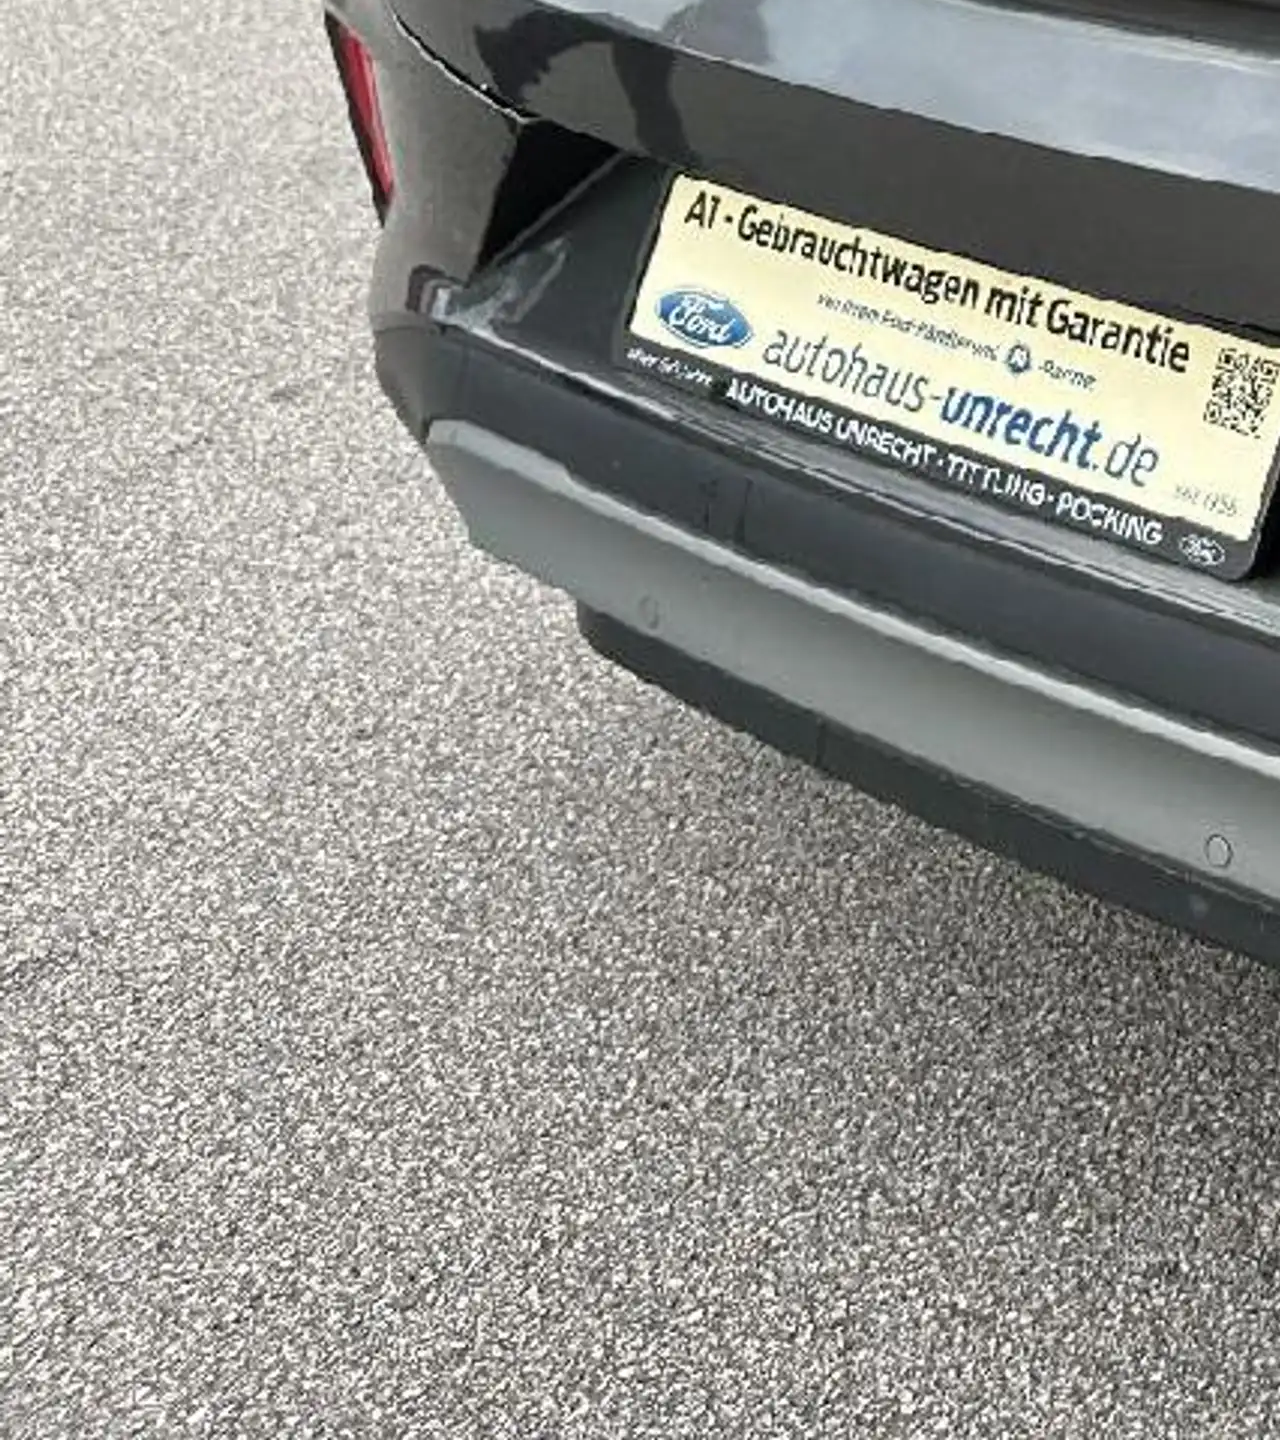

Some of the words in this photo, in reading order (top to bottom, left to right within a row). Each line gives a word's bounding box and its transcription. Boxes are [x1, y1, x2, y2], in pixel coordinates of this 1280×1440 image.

[737, 205, 980, 310] Gebrauchtwagen
[985, 286, 1043, 329] mit
[1047, 298, 1191, 374] Garantie
[725, 377, 834, 434] AUTOHAUS
[836, 417, 938, 468] UNRECHT
[947, 450, 1046, 506] TITTLING
[1055, 491, 1164, 546] POCKING
[762, 329, 1160, 488] autohaus-unrecht.de
